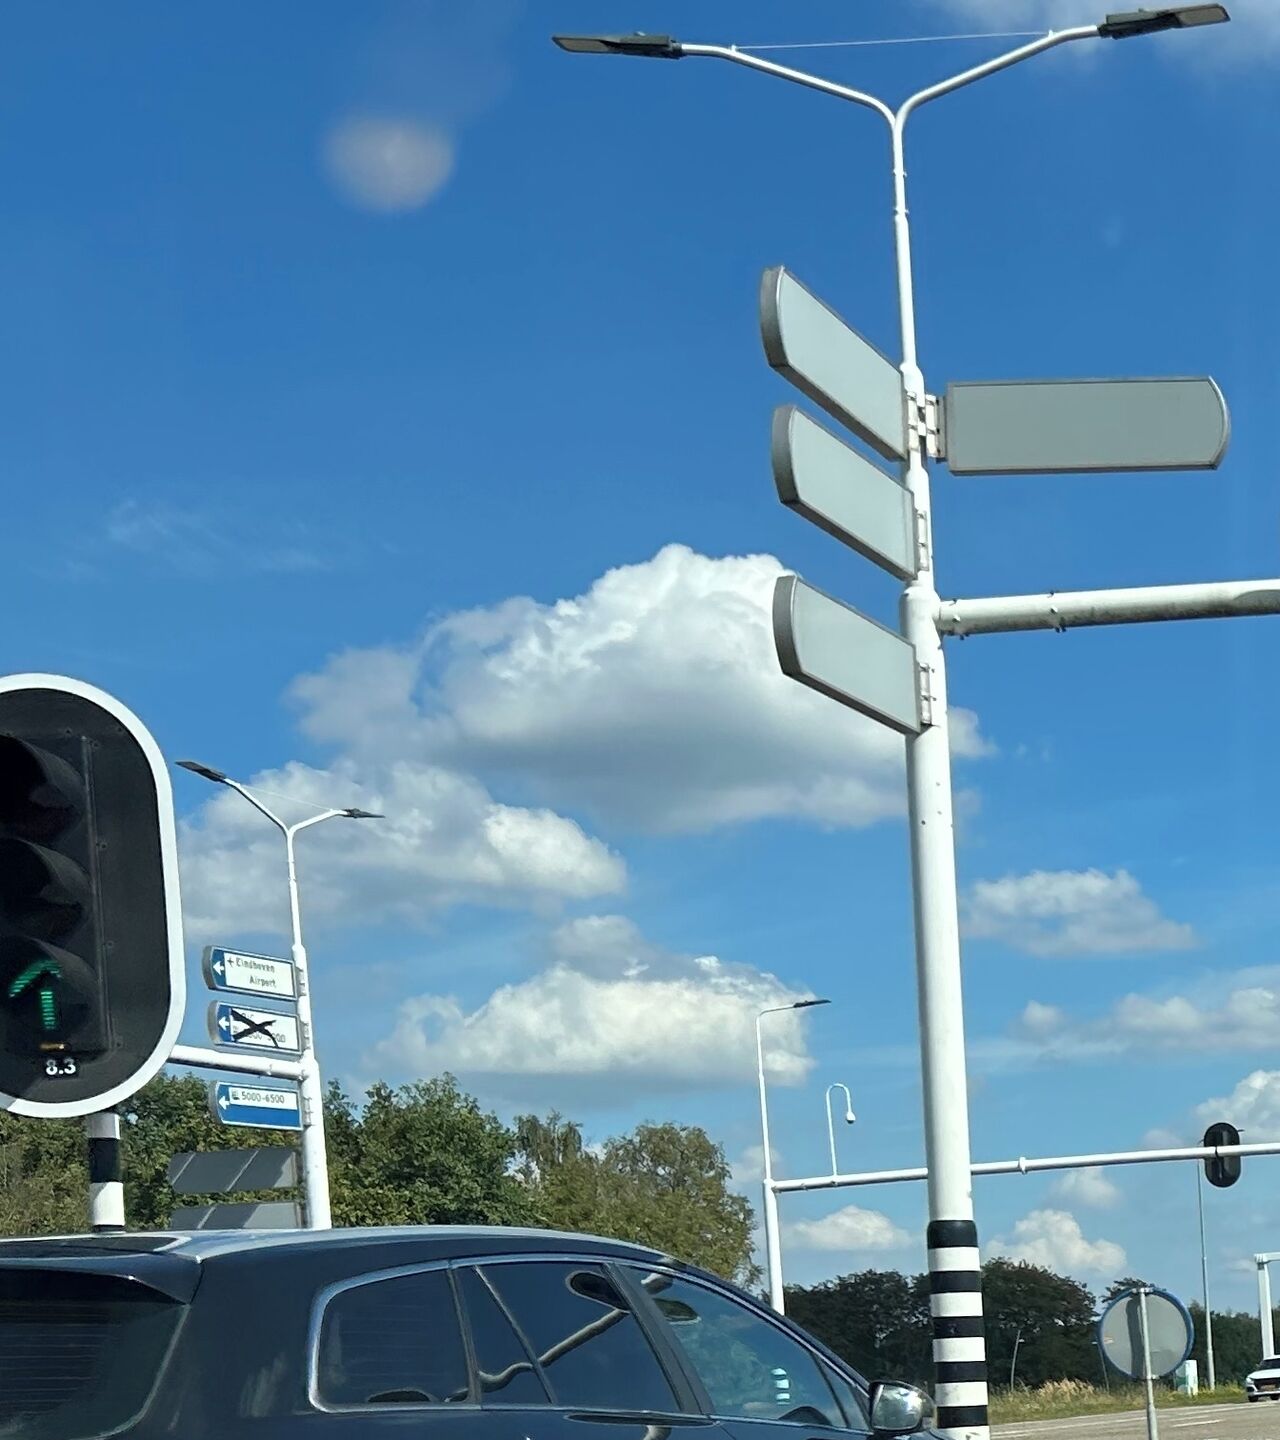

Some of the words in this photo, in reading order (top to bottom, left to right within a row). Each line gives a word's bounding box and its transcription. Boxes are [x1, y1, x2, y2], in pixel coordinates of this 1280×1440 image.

[249, 975, 277, 988] Airport
[45, 1058, 76, 1075] 8.3
[241, 1091, 285, 1104] 5000-6500
